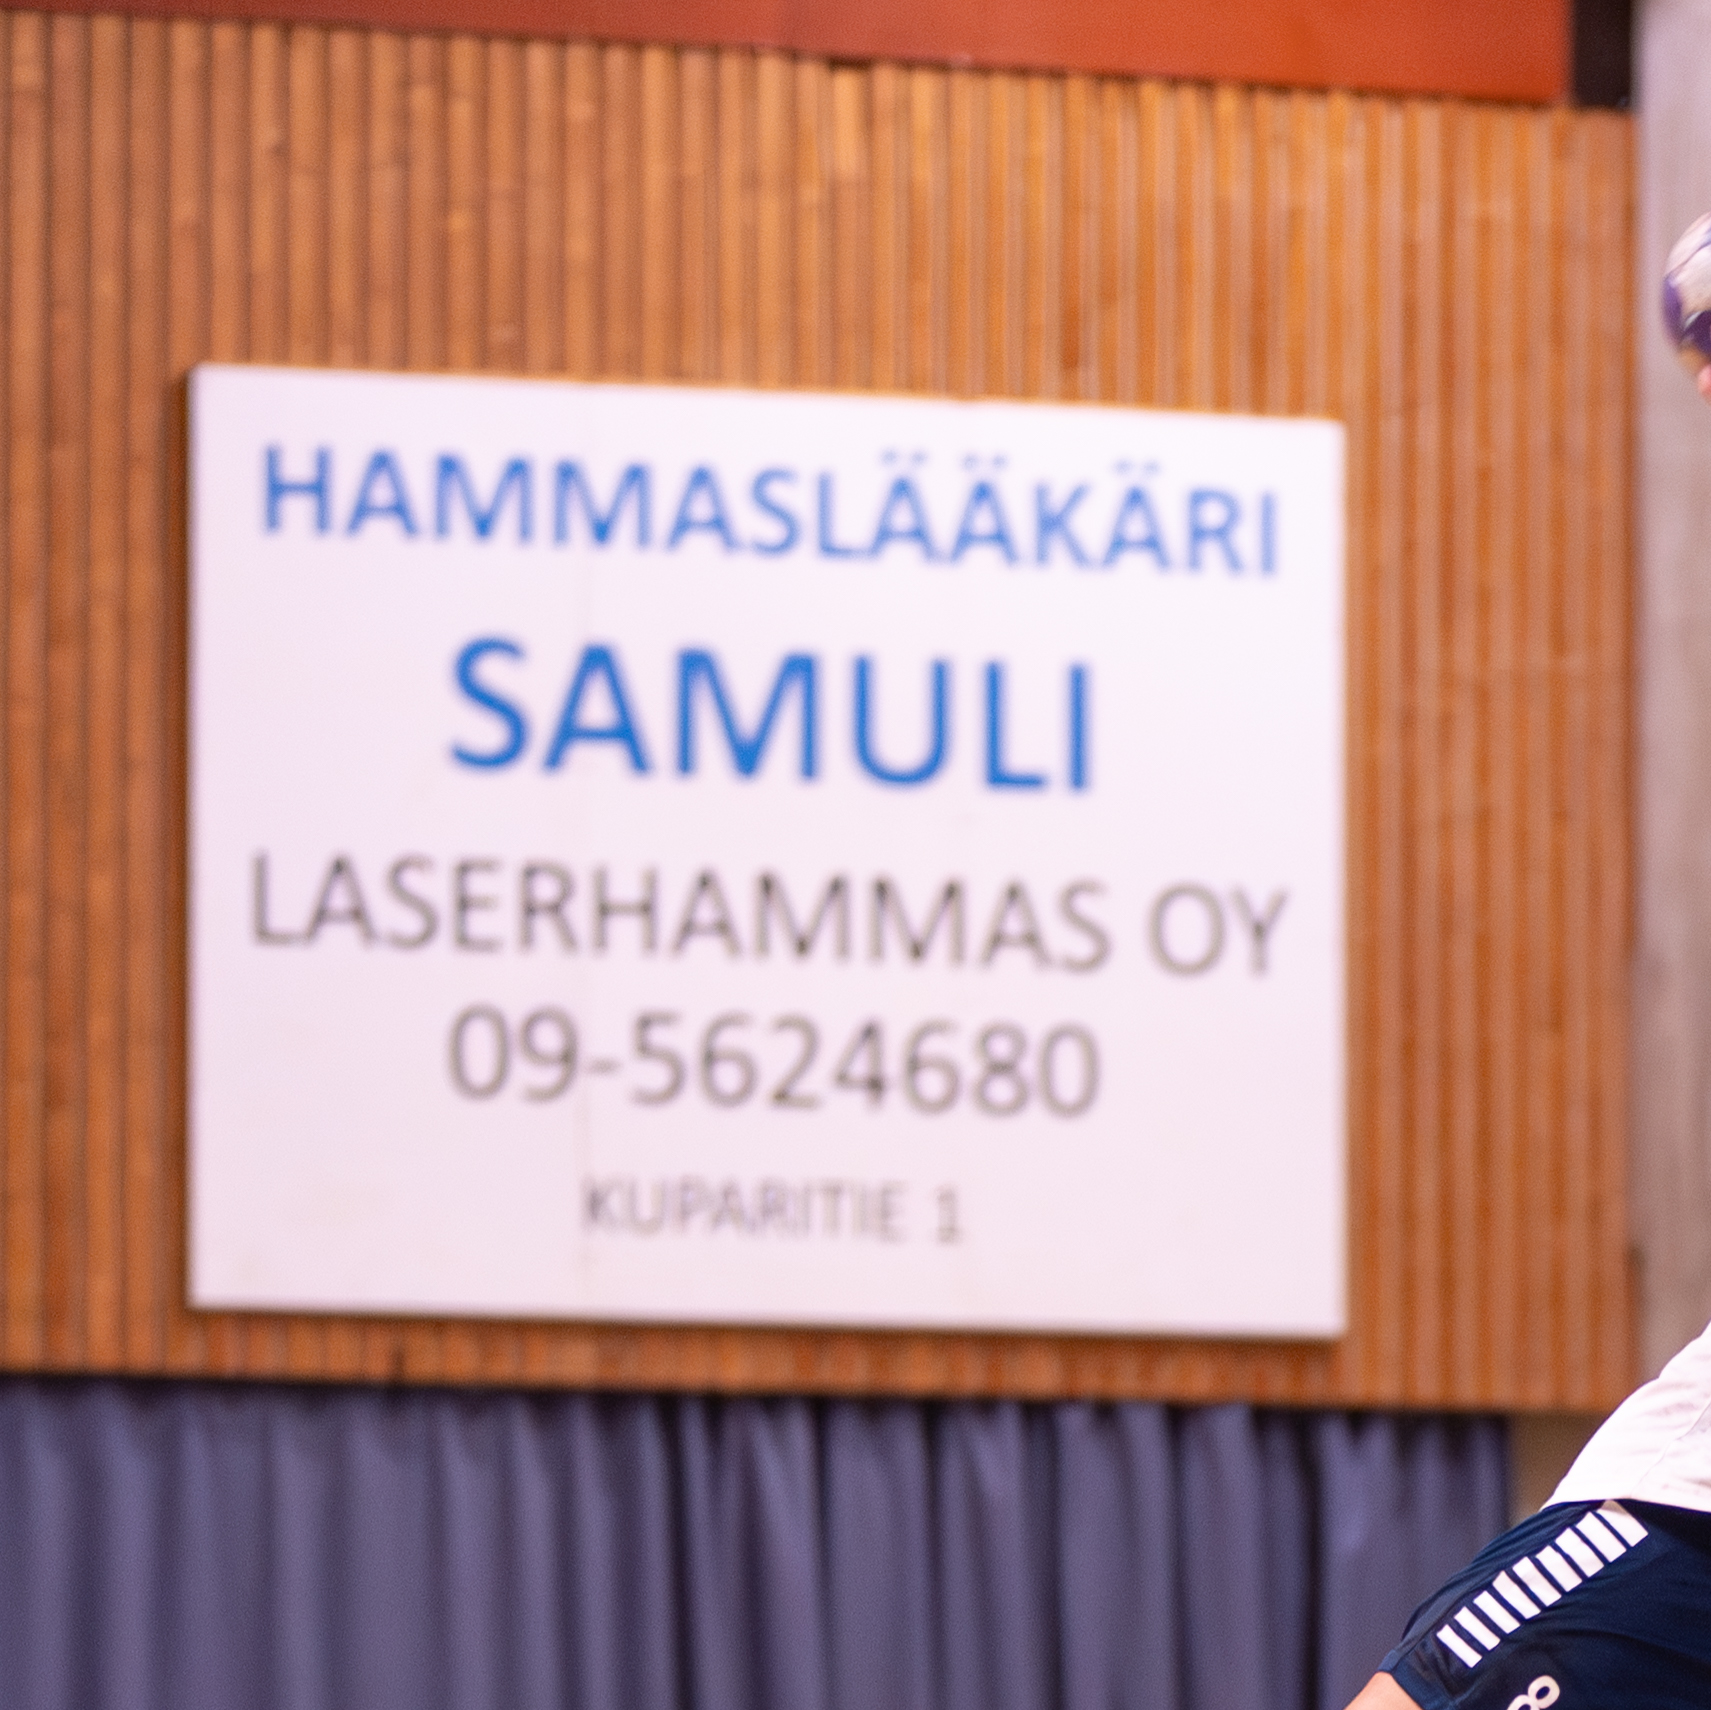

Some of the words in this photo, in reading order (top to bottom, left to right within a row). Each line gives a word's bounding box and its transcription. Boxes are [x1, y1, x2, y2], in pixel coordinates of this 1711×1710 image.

[262, 440, 1281, 579] HAMMASLÄÄKÄRI
[448, 635, 1092, 794] SAMULI
[251, 850, 1112, 976] LASERHAMMAS
[1146, 882, 1291, 979] OY
[446, 1000, 1102, 1119] 09-5624680
[582, 1177, 907, 1245] KUPARITIE
[934, 1186, 963, 1245] 1
